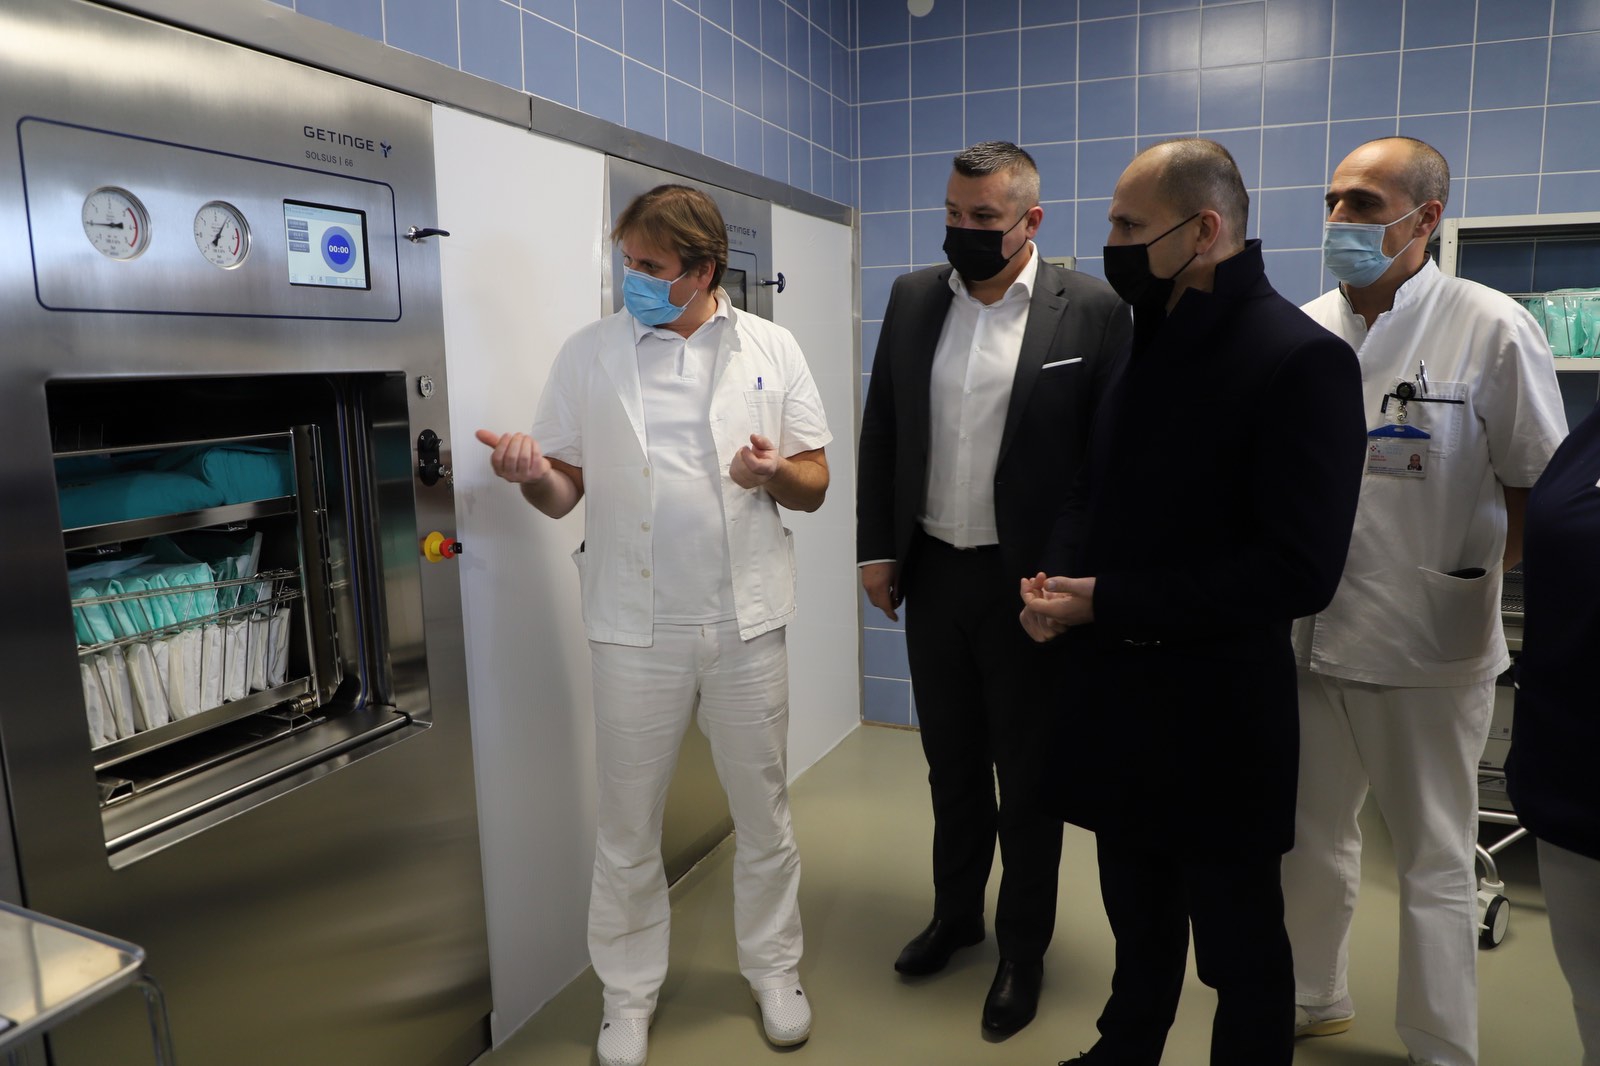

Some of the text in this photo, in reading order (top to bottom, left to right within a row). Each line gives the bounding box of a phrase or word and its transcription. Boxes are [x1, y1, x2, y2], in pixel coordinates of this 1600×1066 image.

[303, 125, 375, 152] GETINGE
[305, 150, 337, 164] SOLSUS
[328, 244, 349, 254] 00:00
